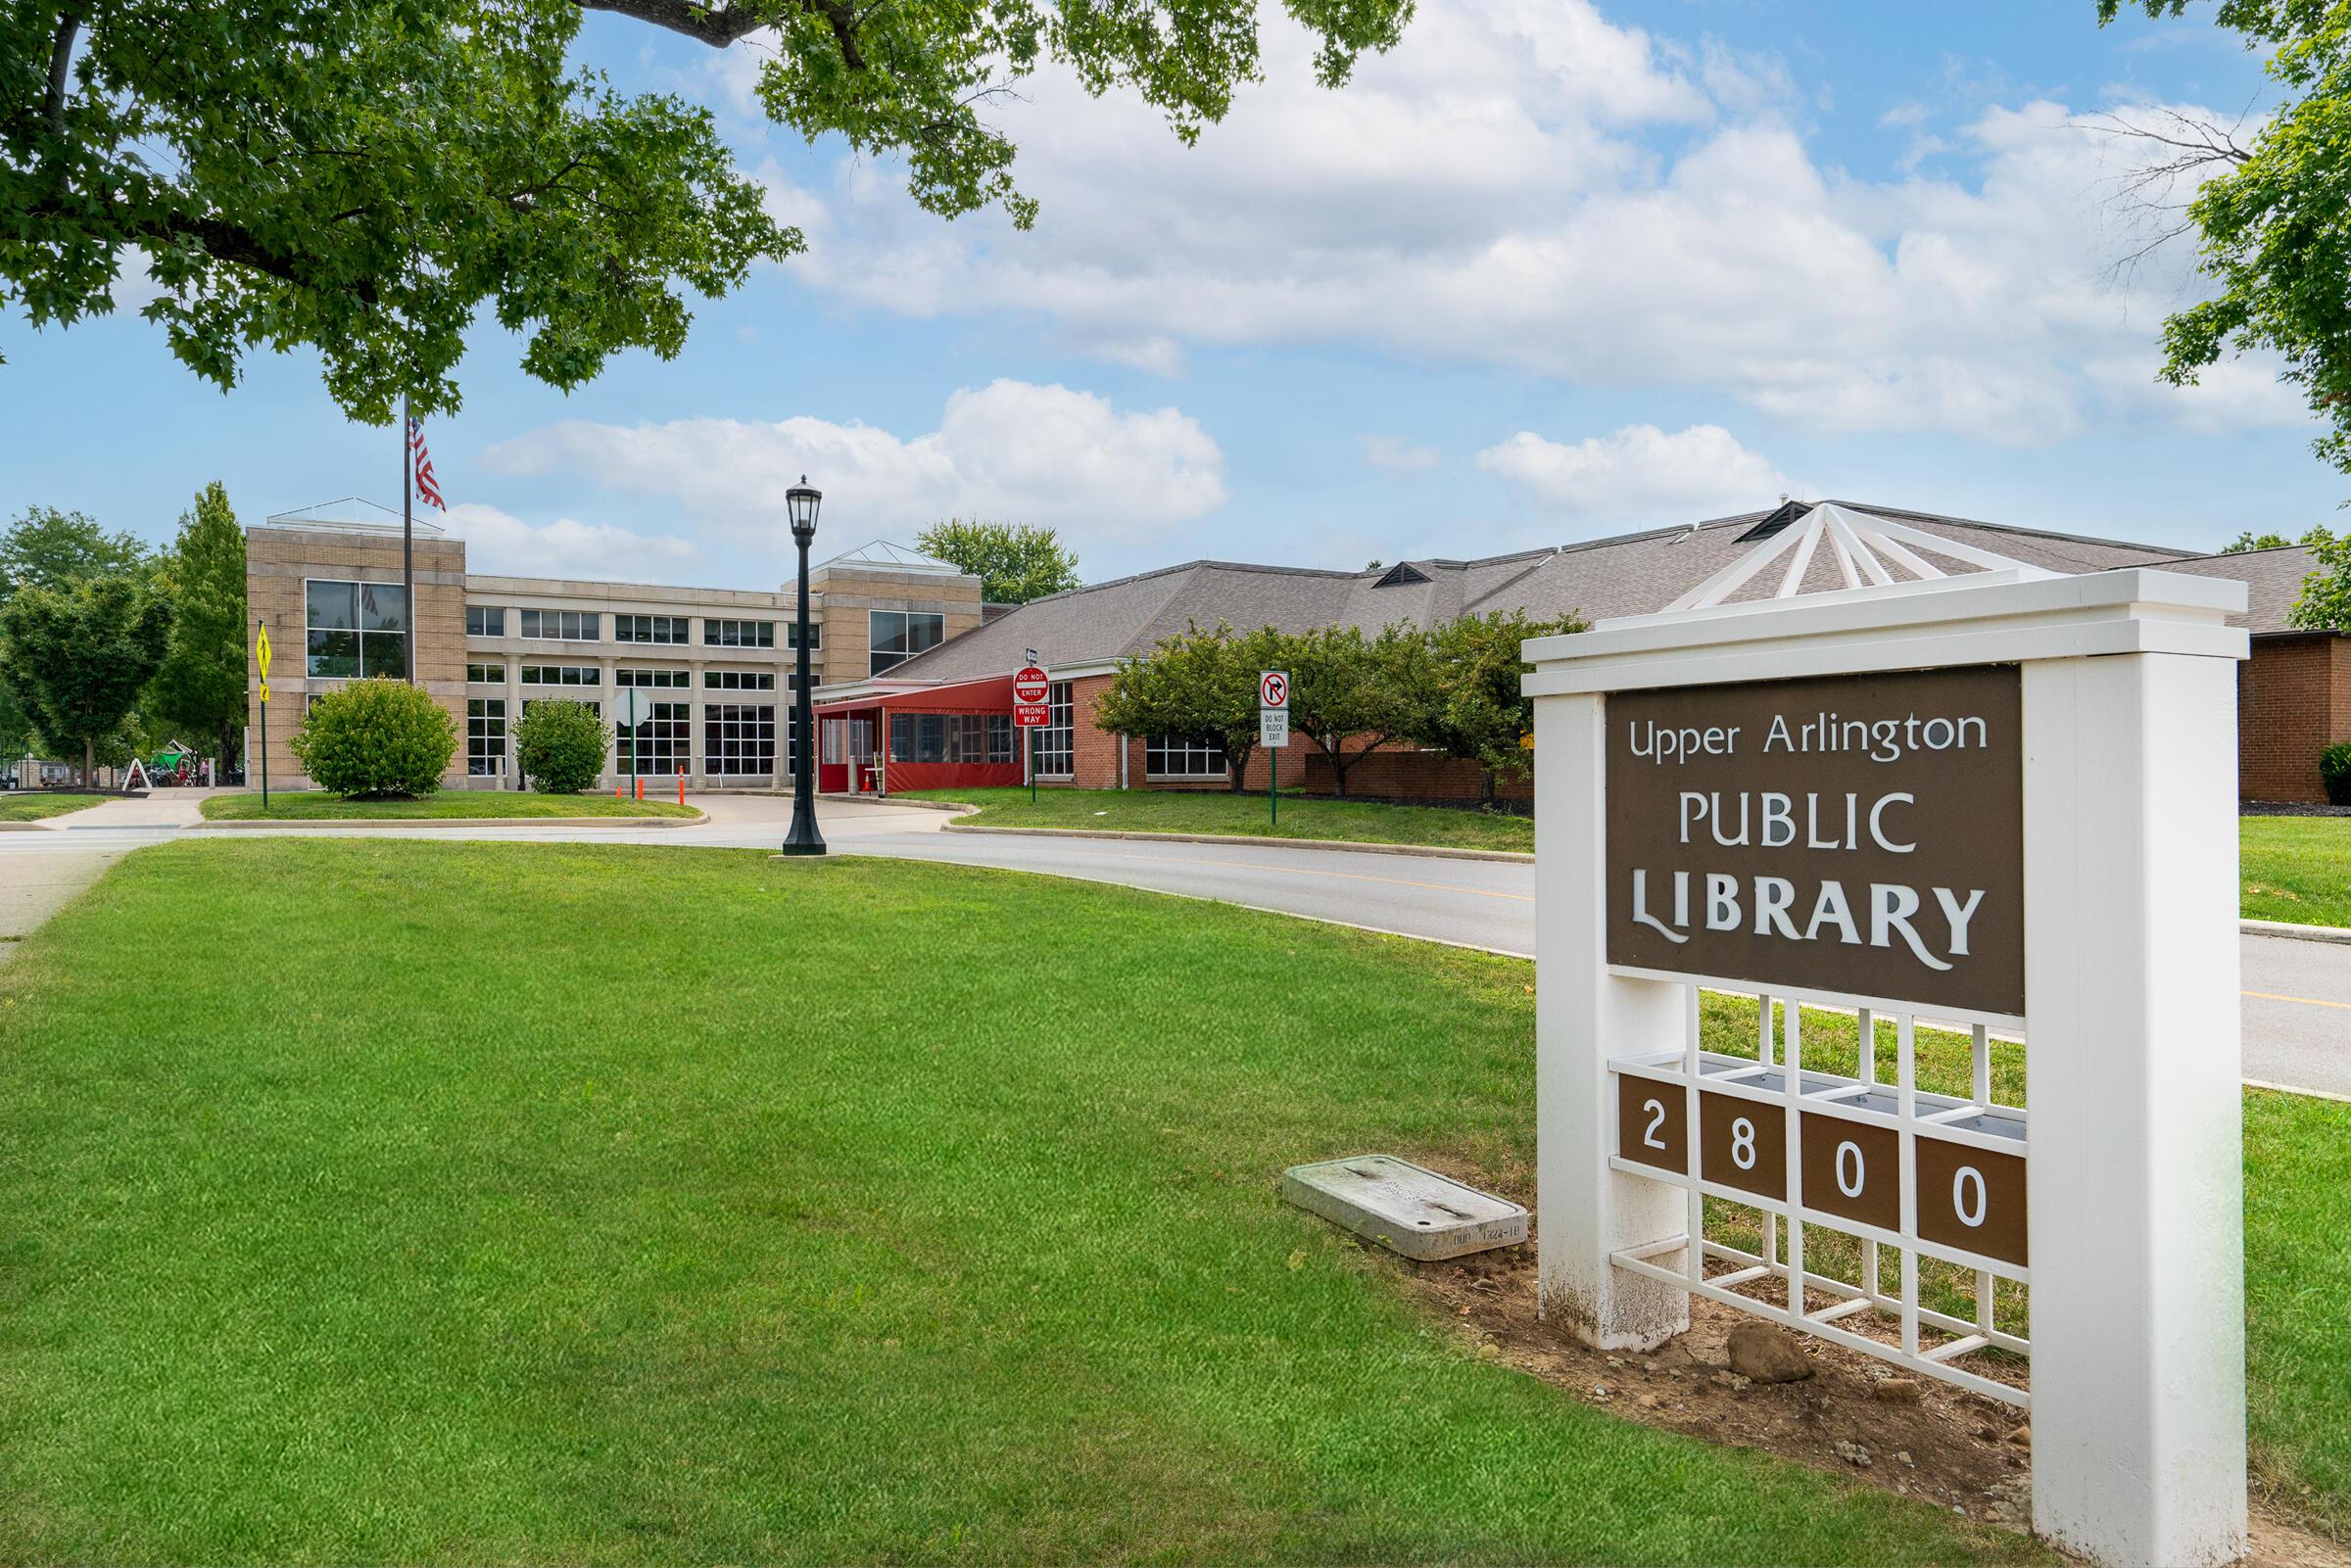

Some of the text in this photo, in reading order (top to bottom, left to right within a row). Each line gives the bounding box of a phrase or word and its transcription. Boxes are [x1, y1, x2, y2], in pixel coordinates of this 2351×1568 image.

[1019, 706, 1046, 715] WRONG
[1024, 715, 1040, 724] WAY
[1265, 714, 1284, 723] DO NOT
[1629, 712, 1988, 765] Upper Arlington
[1679, 791, 1917, 853] PUBLIC
[1632, 869, 1986, 972] LIBRARY
